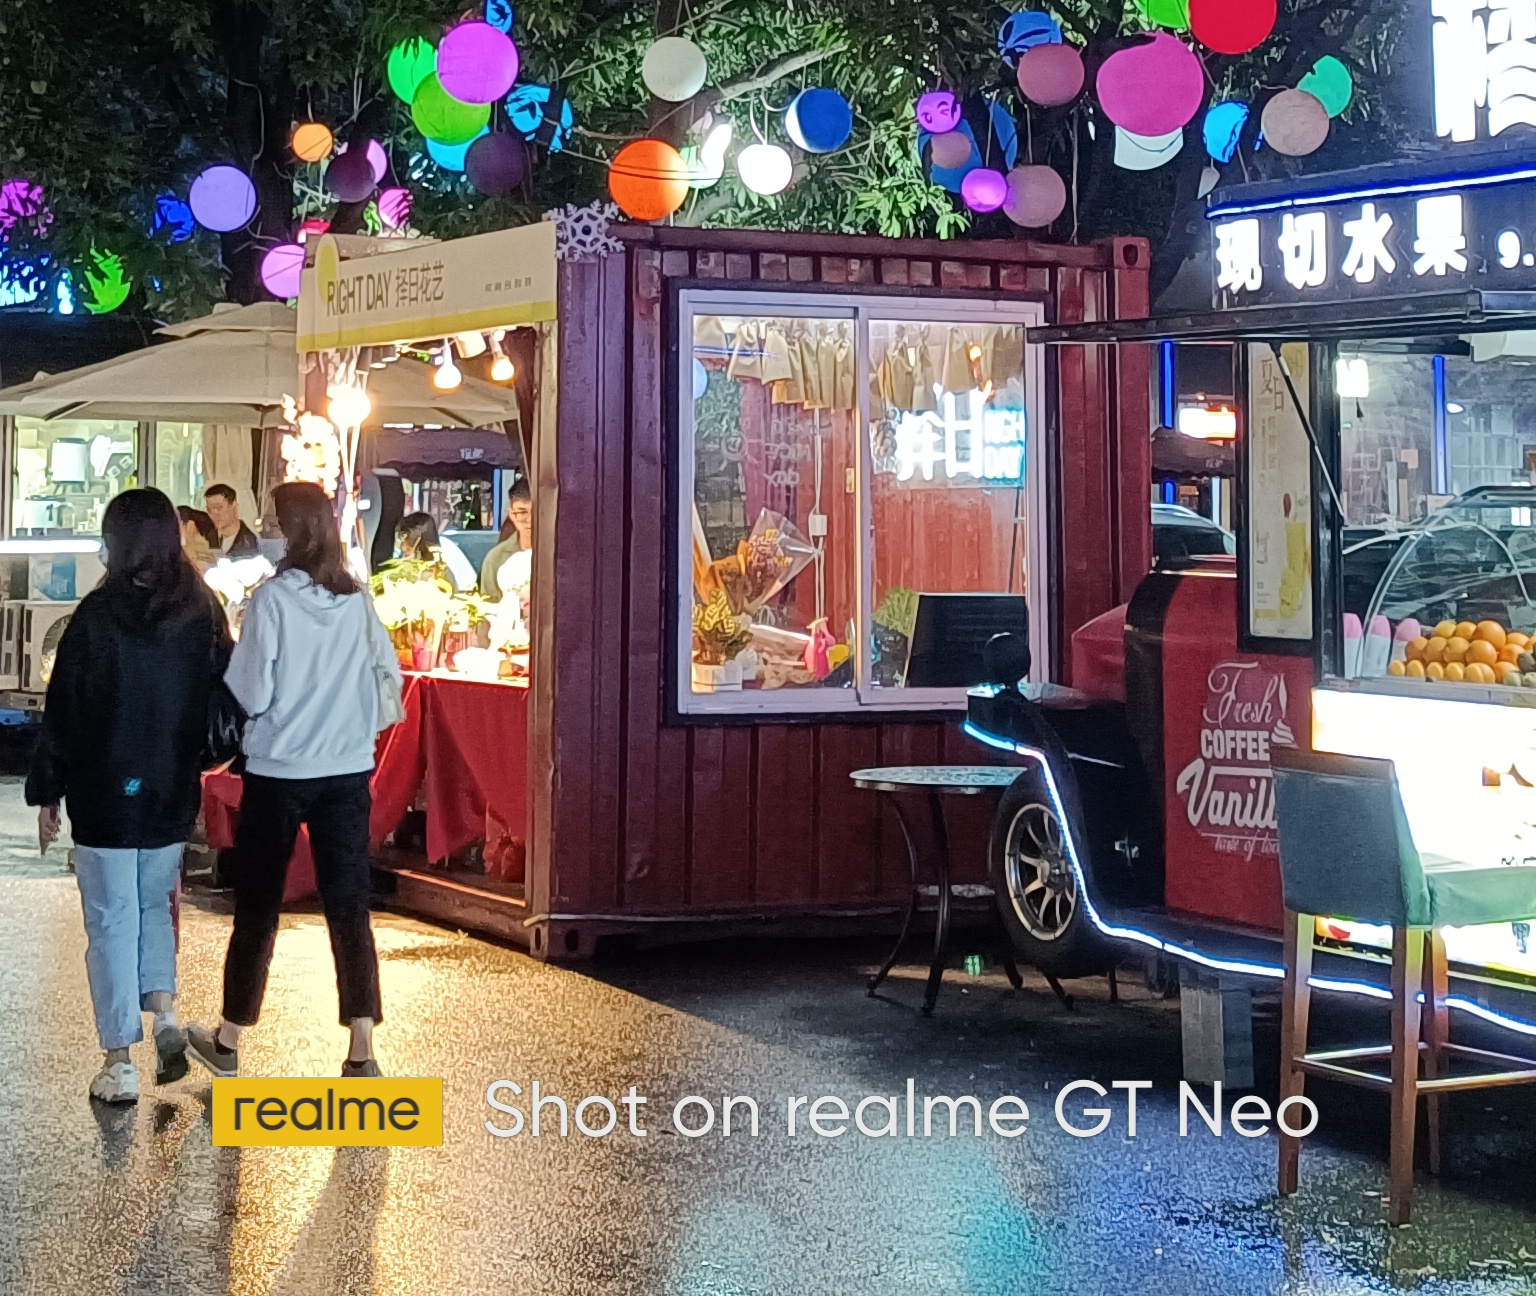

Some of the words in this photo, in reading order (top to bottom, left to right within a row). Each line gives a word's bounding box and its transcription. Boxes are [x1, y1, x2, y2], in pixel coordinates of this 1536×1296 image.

[1215, 194, 1468, 294] 现切水果
[326, 275, 363, 318] RIGHT
[366, 269, 392, 311] DAY
[395, 260, 445, 308] 择日花艺
[1202, 660, 1276, 728] Fresh
[1200, 728, 1271, 762] COFFEE
[1176, 757, 1279, 829] Vanill
